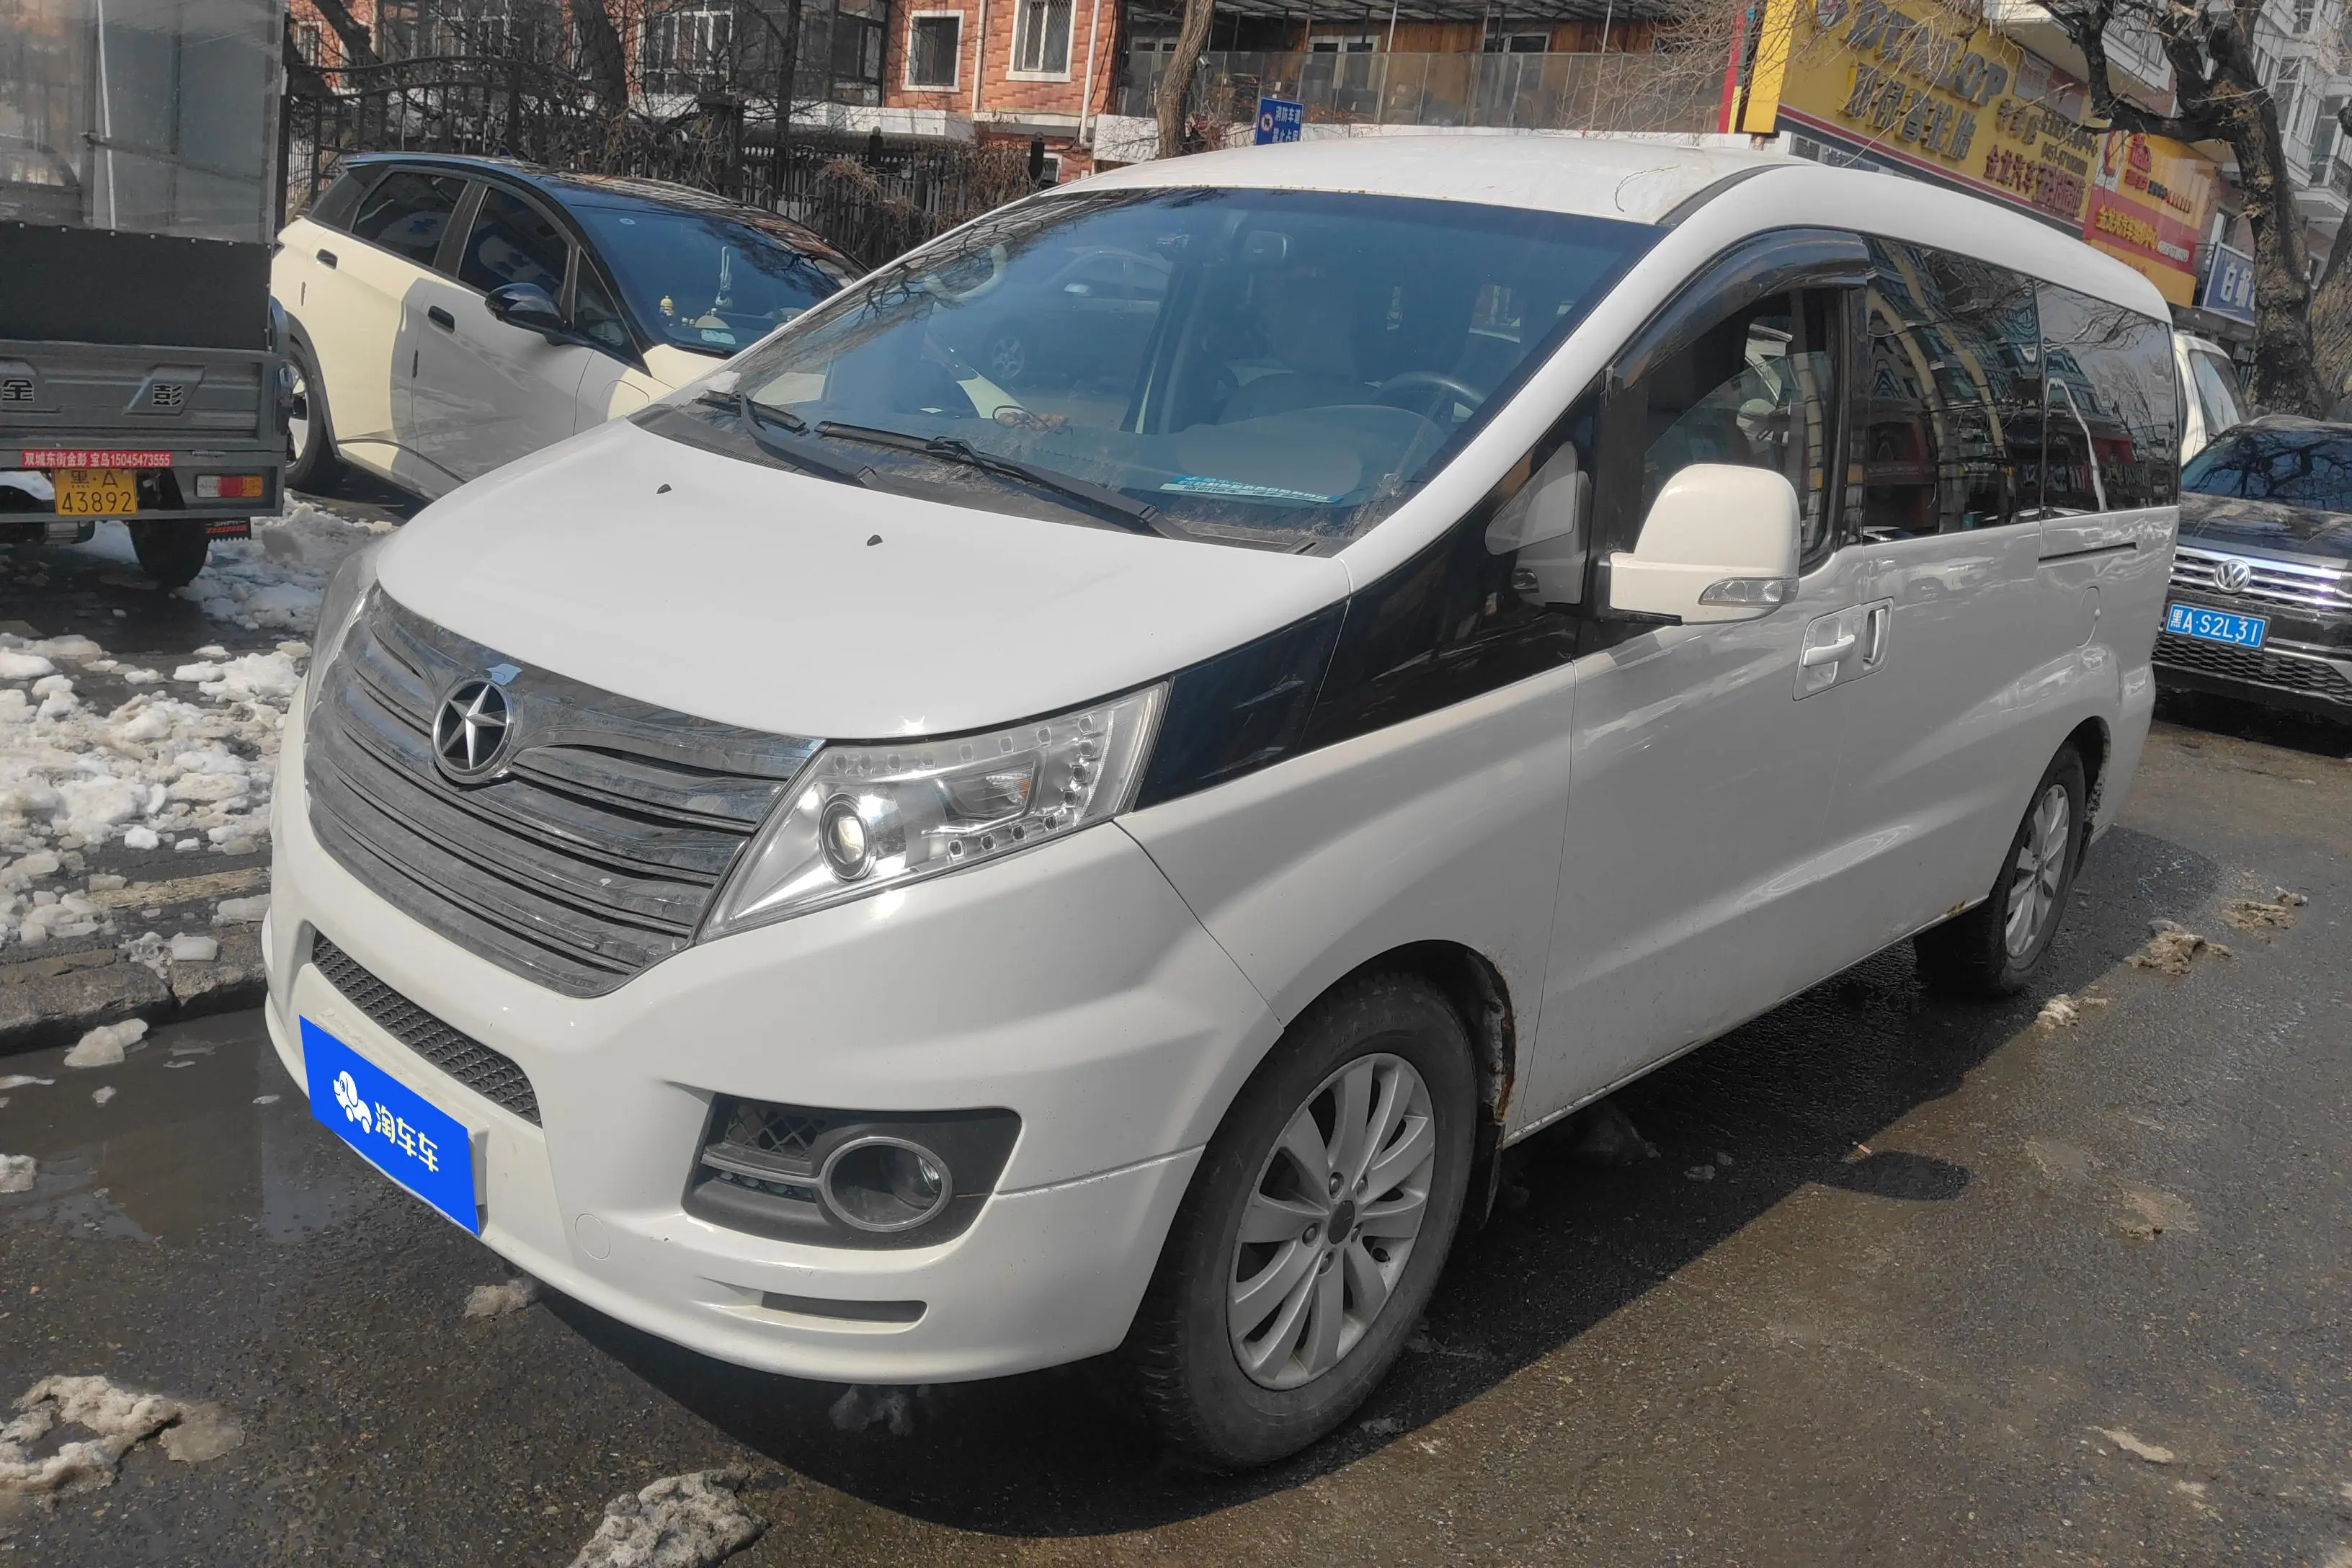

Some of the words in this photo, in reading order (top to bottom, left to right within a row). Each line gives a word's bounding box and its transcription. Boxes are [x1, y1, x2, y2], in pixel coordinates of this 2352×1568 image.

[1275, 106, 1301, 124] 消防车道
[1, 379, 34, 402] 金
[152, 383, 183, 406] 彭
[24, 452, 87, 468] 双城东街金彭
[62, 491, 132, 512] 43892
